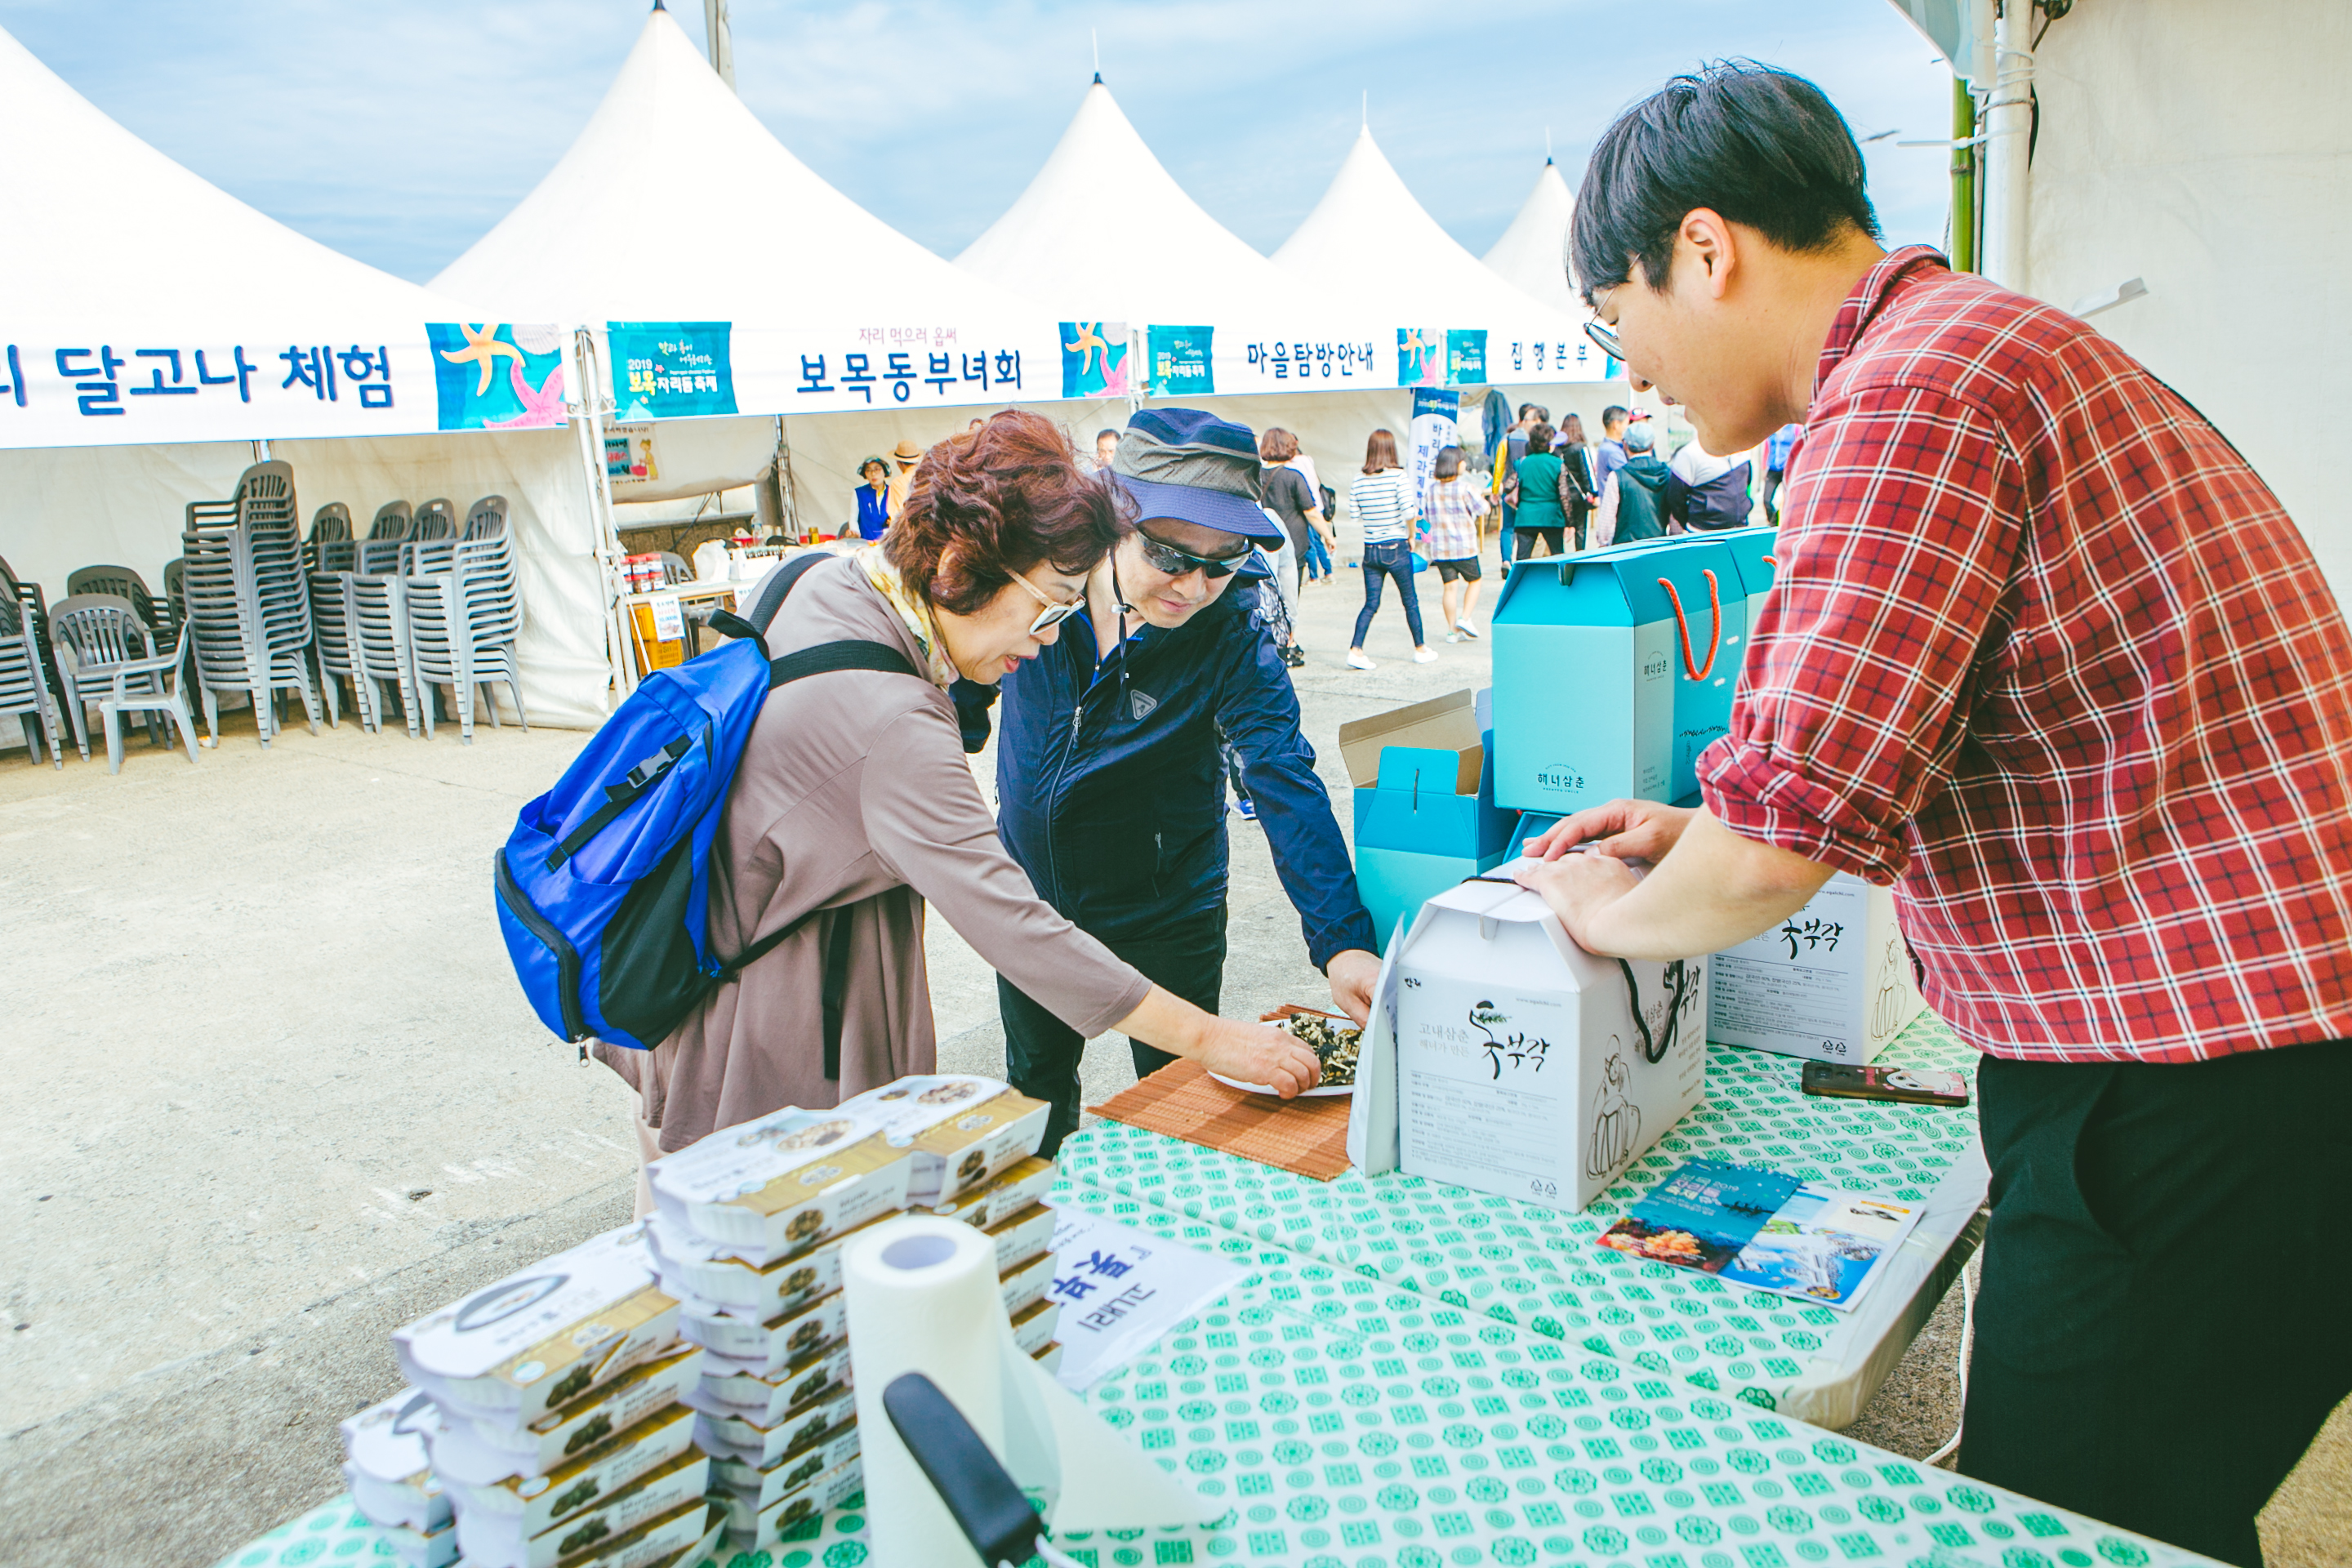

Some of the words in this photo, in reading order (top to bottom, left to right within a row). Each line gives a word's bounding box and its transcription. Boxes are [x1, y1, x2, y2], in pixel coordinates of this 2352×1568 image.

[858, 327, 885, 345] 자리
[890, 327, 928, 346] 먹으러
[932, 327, 958, 347] 옵써
[627, 358, 653, 370] 2019
[1246, 341, 1374, 379] 마을탐방안내
[1511, 341, 1588, 372] 집행본부
[55, 344, 258, 416] 달고나
[279, 344, 395, 408] 체험
[628, 370, 657, 396] 보목
[795, 349, 1022, 403] 보목동부녀회
[1537, 773, 1584, 789] 해녀삼춘
[1419, 1022, 1470, 1045] 고내삼춘
